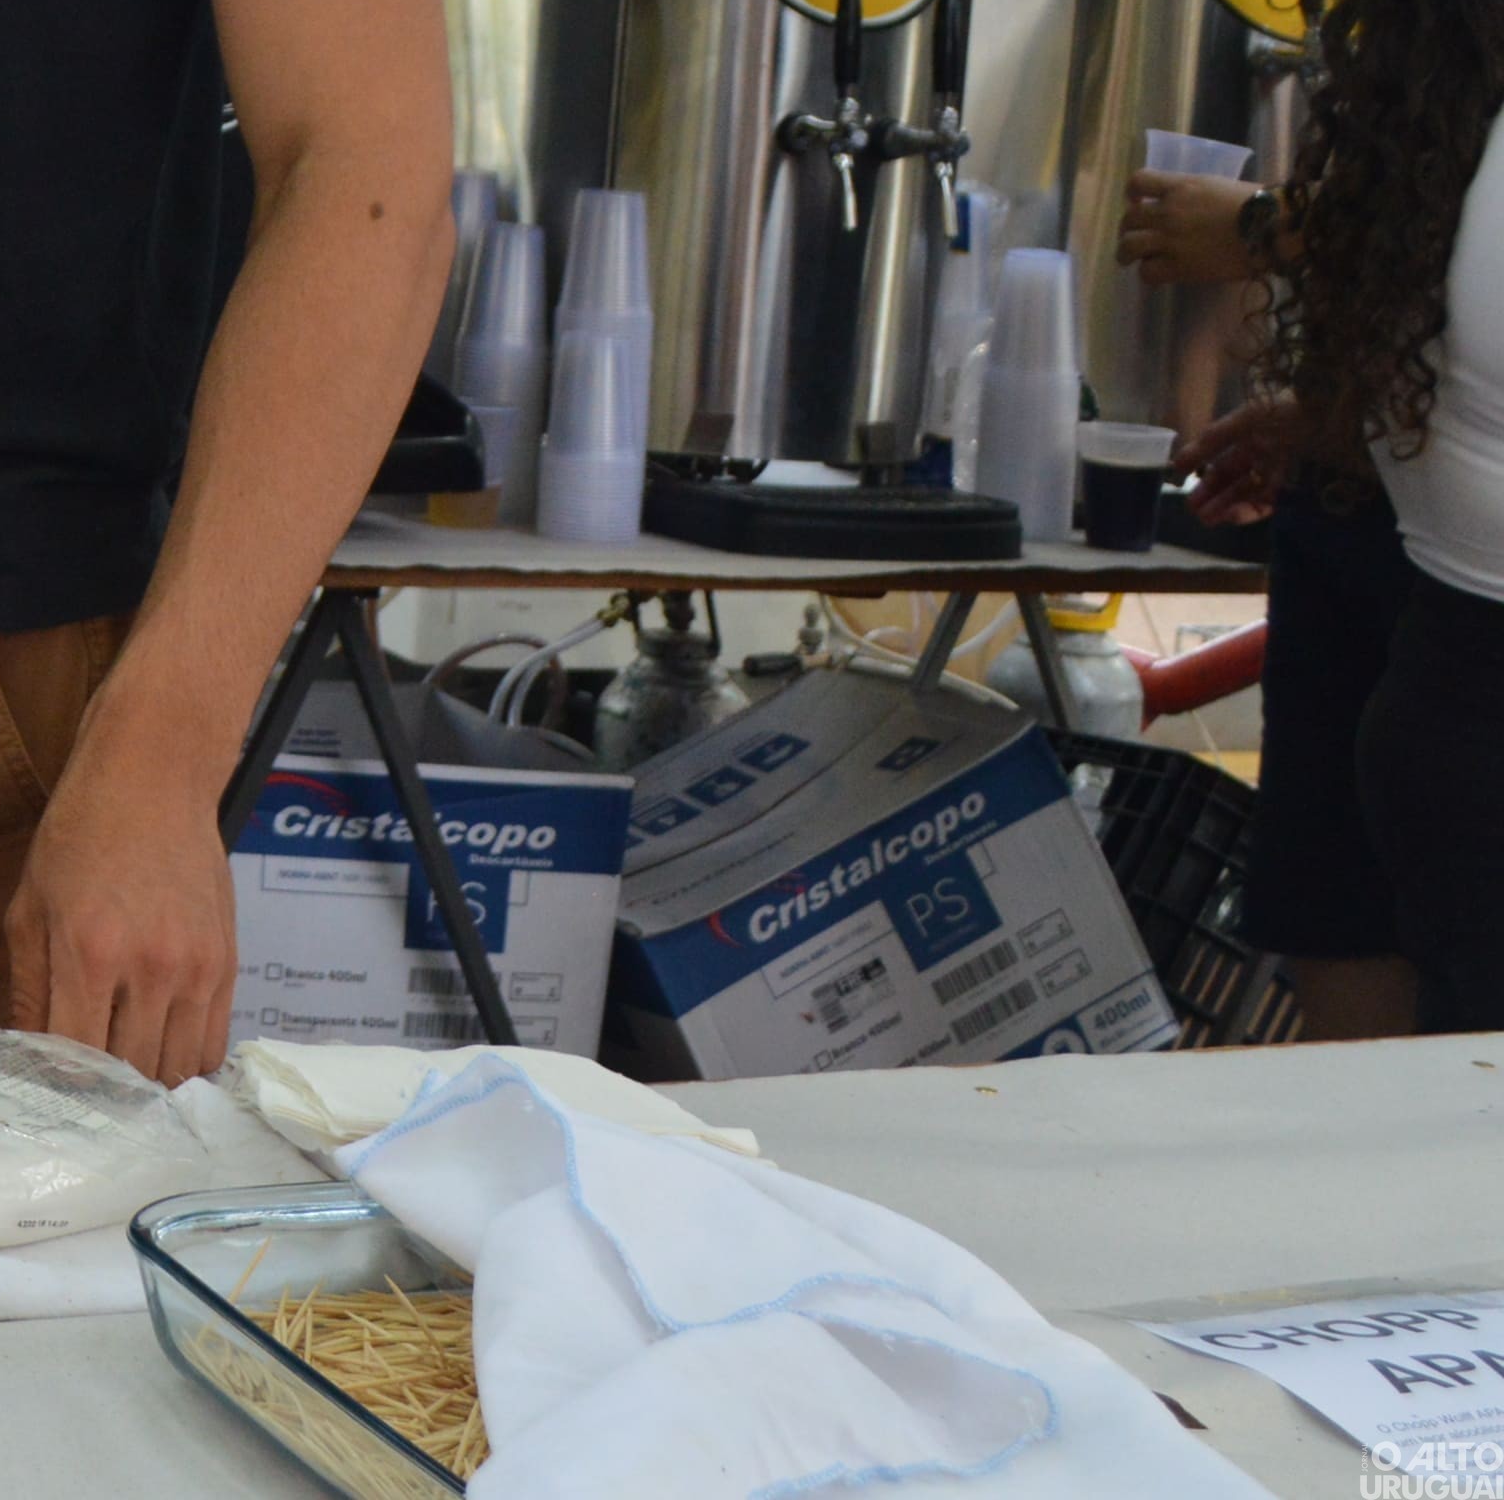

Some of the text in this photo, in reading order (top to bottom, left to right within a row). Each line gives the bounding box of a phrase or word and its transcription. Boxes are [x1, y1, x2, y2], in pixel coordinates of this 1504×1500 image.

[273, 804, 557, 855] Cristacopo
[748, 792, 986, 944] Cristalcopo
[904, 876, 972, 939] PS
[1094, 987, 1152, 1030] 400ml
[1200, 1309, 1480, 1352] CHOPP
